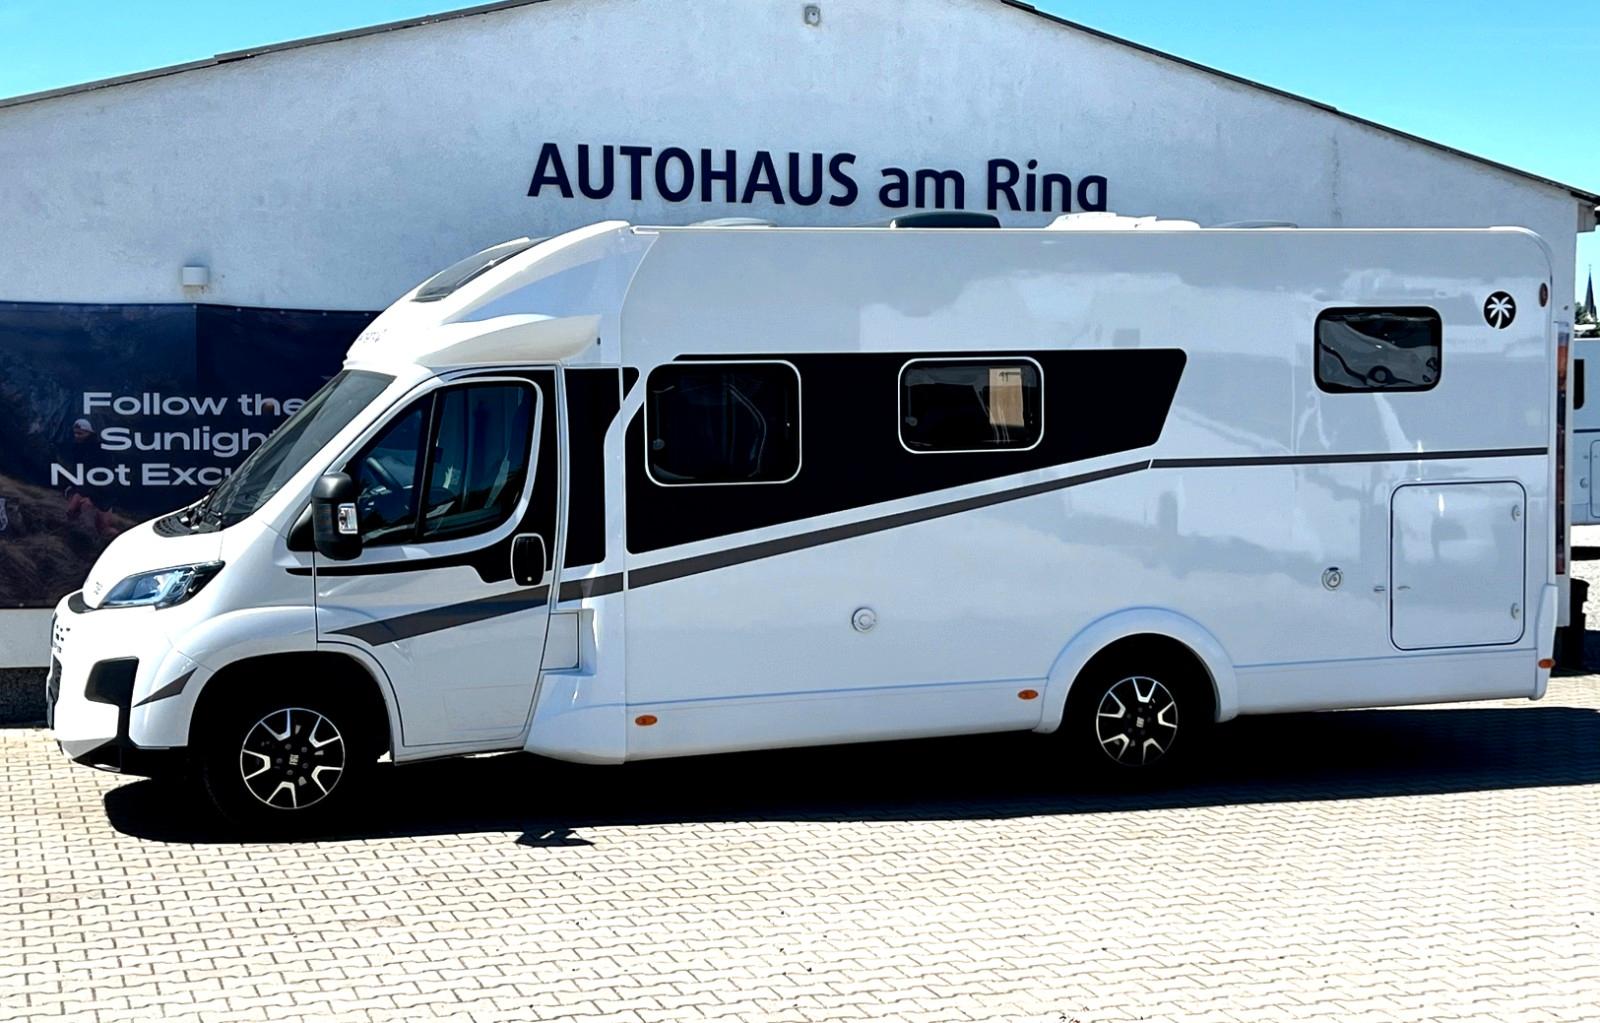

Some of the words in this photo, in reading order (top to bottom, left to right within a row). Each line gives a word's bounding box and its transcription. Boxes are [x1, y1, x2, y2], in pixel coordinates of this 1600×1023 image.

[526, 142, 859, 207] AUTOHAUS
[879, 165, 965, 210] am
[83, 392, 228, 416] Follow
[237, 393, 306, 417] the
[100, 425, 277, 458] Sunligh
[50, 463, 131, 486] Not
[141, 463, 232, 486] Exc
